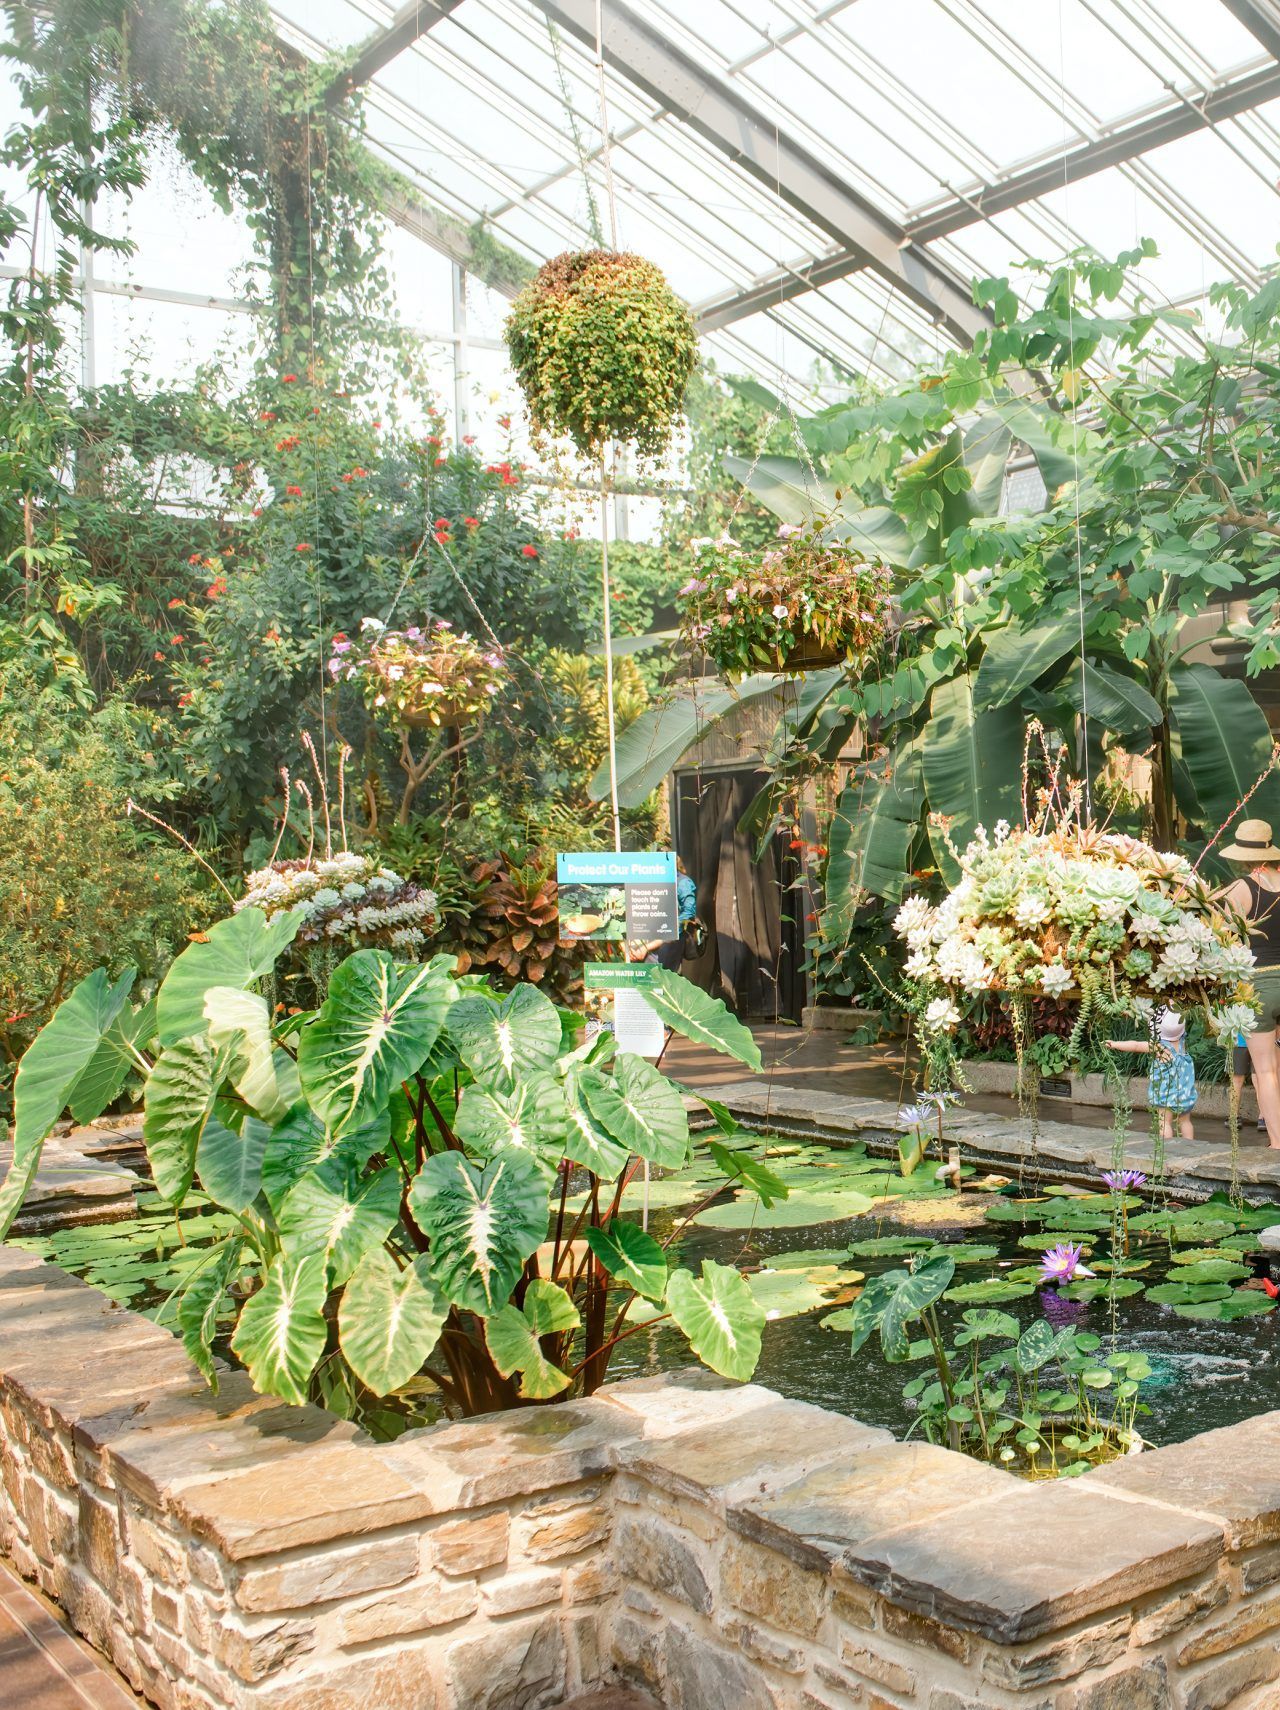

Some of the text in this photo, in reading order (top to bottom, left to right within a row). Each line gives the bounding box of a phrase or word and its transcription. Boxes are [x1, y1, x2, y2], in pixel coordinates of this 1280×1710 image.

[568, 864, 666, 875] Protect Our Plants
[632, 903, 651, 911] plants
